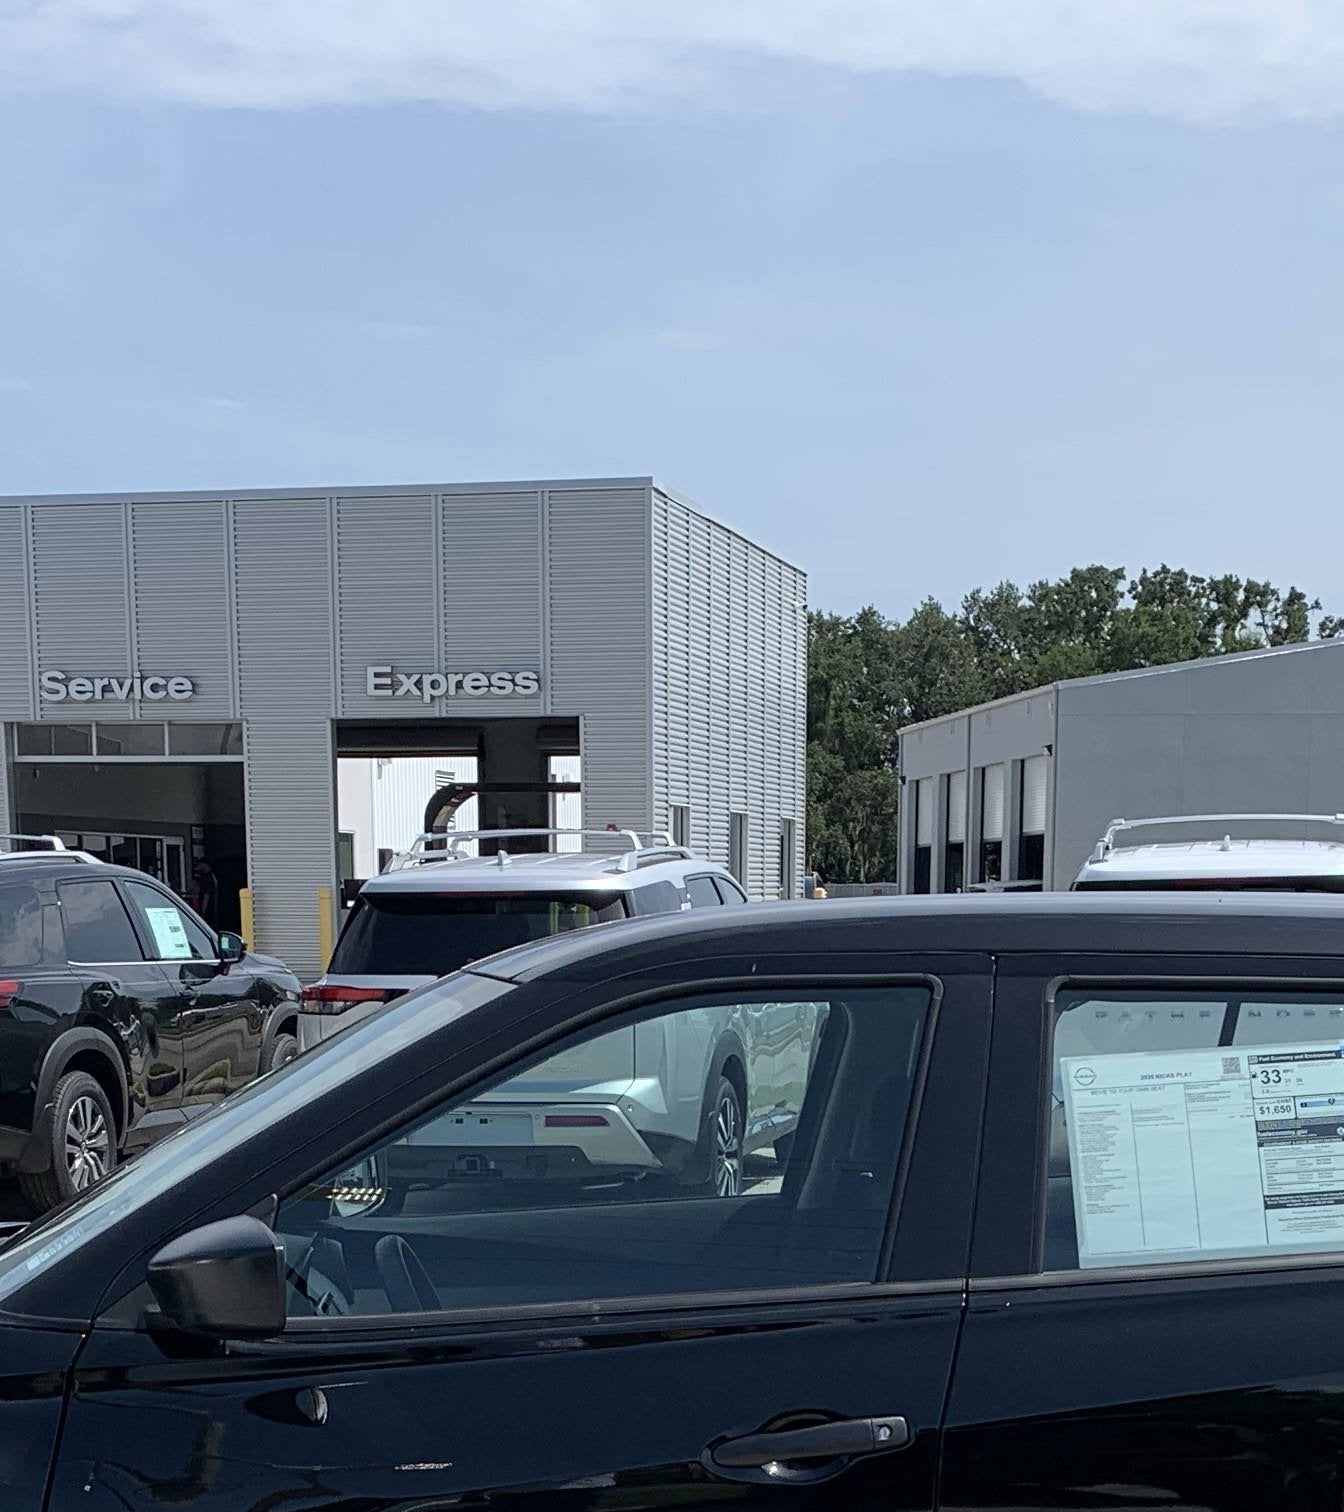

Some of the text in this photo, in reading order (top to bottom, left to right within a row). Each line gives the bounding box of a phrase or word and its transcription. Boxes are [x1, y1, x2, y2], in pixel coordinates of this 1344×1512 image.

[40, 665, 540, 703] Service Express
[1260, 1069, 1282, 1085] 33
[1259, 1104, 1292, 1115] $1,650
